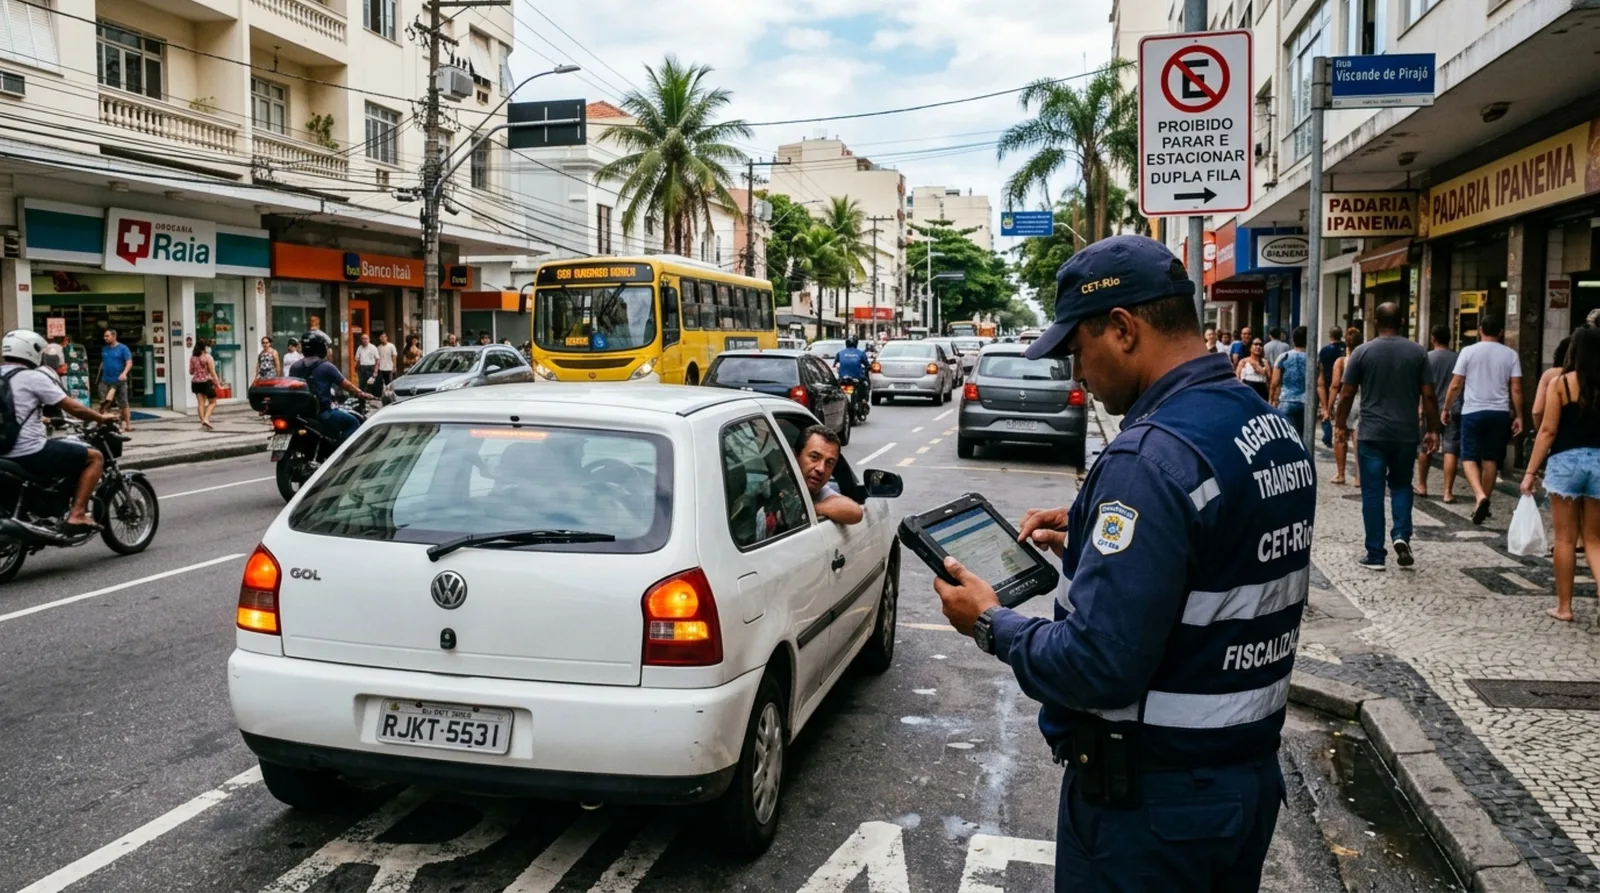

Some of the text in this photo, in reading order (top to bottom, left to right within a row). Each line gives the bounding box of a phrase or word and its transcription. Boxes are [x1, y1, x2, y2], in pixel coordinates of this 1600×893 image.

[1383, 67, 1396, 80] de
[1158, 117, 1233, 133] PROIBIDO
[1162, 134, 1229, 149] PARAR E
[1146, 149, 1245, 166] ESTACIONAR
[1151, 169, 1241, 185] DUPLA FILA
[1432, 142, 1577, 226] PADARIA IPANEMA
[1329, 197, 1411, 213] PADARIA
[1327, 216, 1413, 231] IPANEMA
[152, 232, 210, 265] Raia
[361, 260, 392, 279] Banco
[1081, 276, 1120, 294] CET-Rio
[289, 567, 322, 581] GOL
